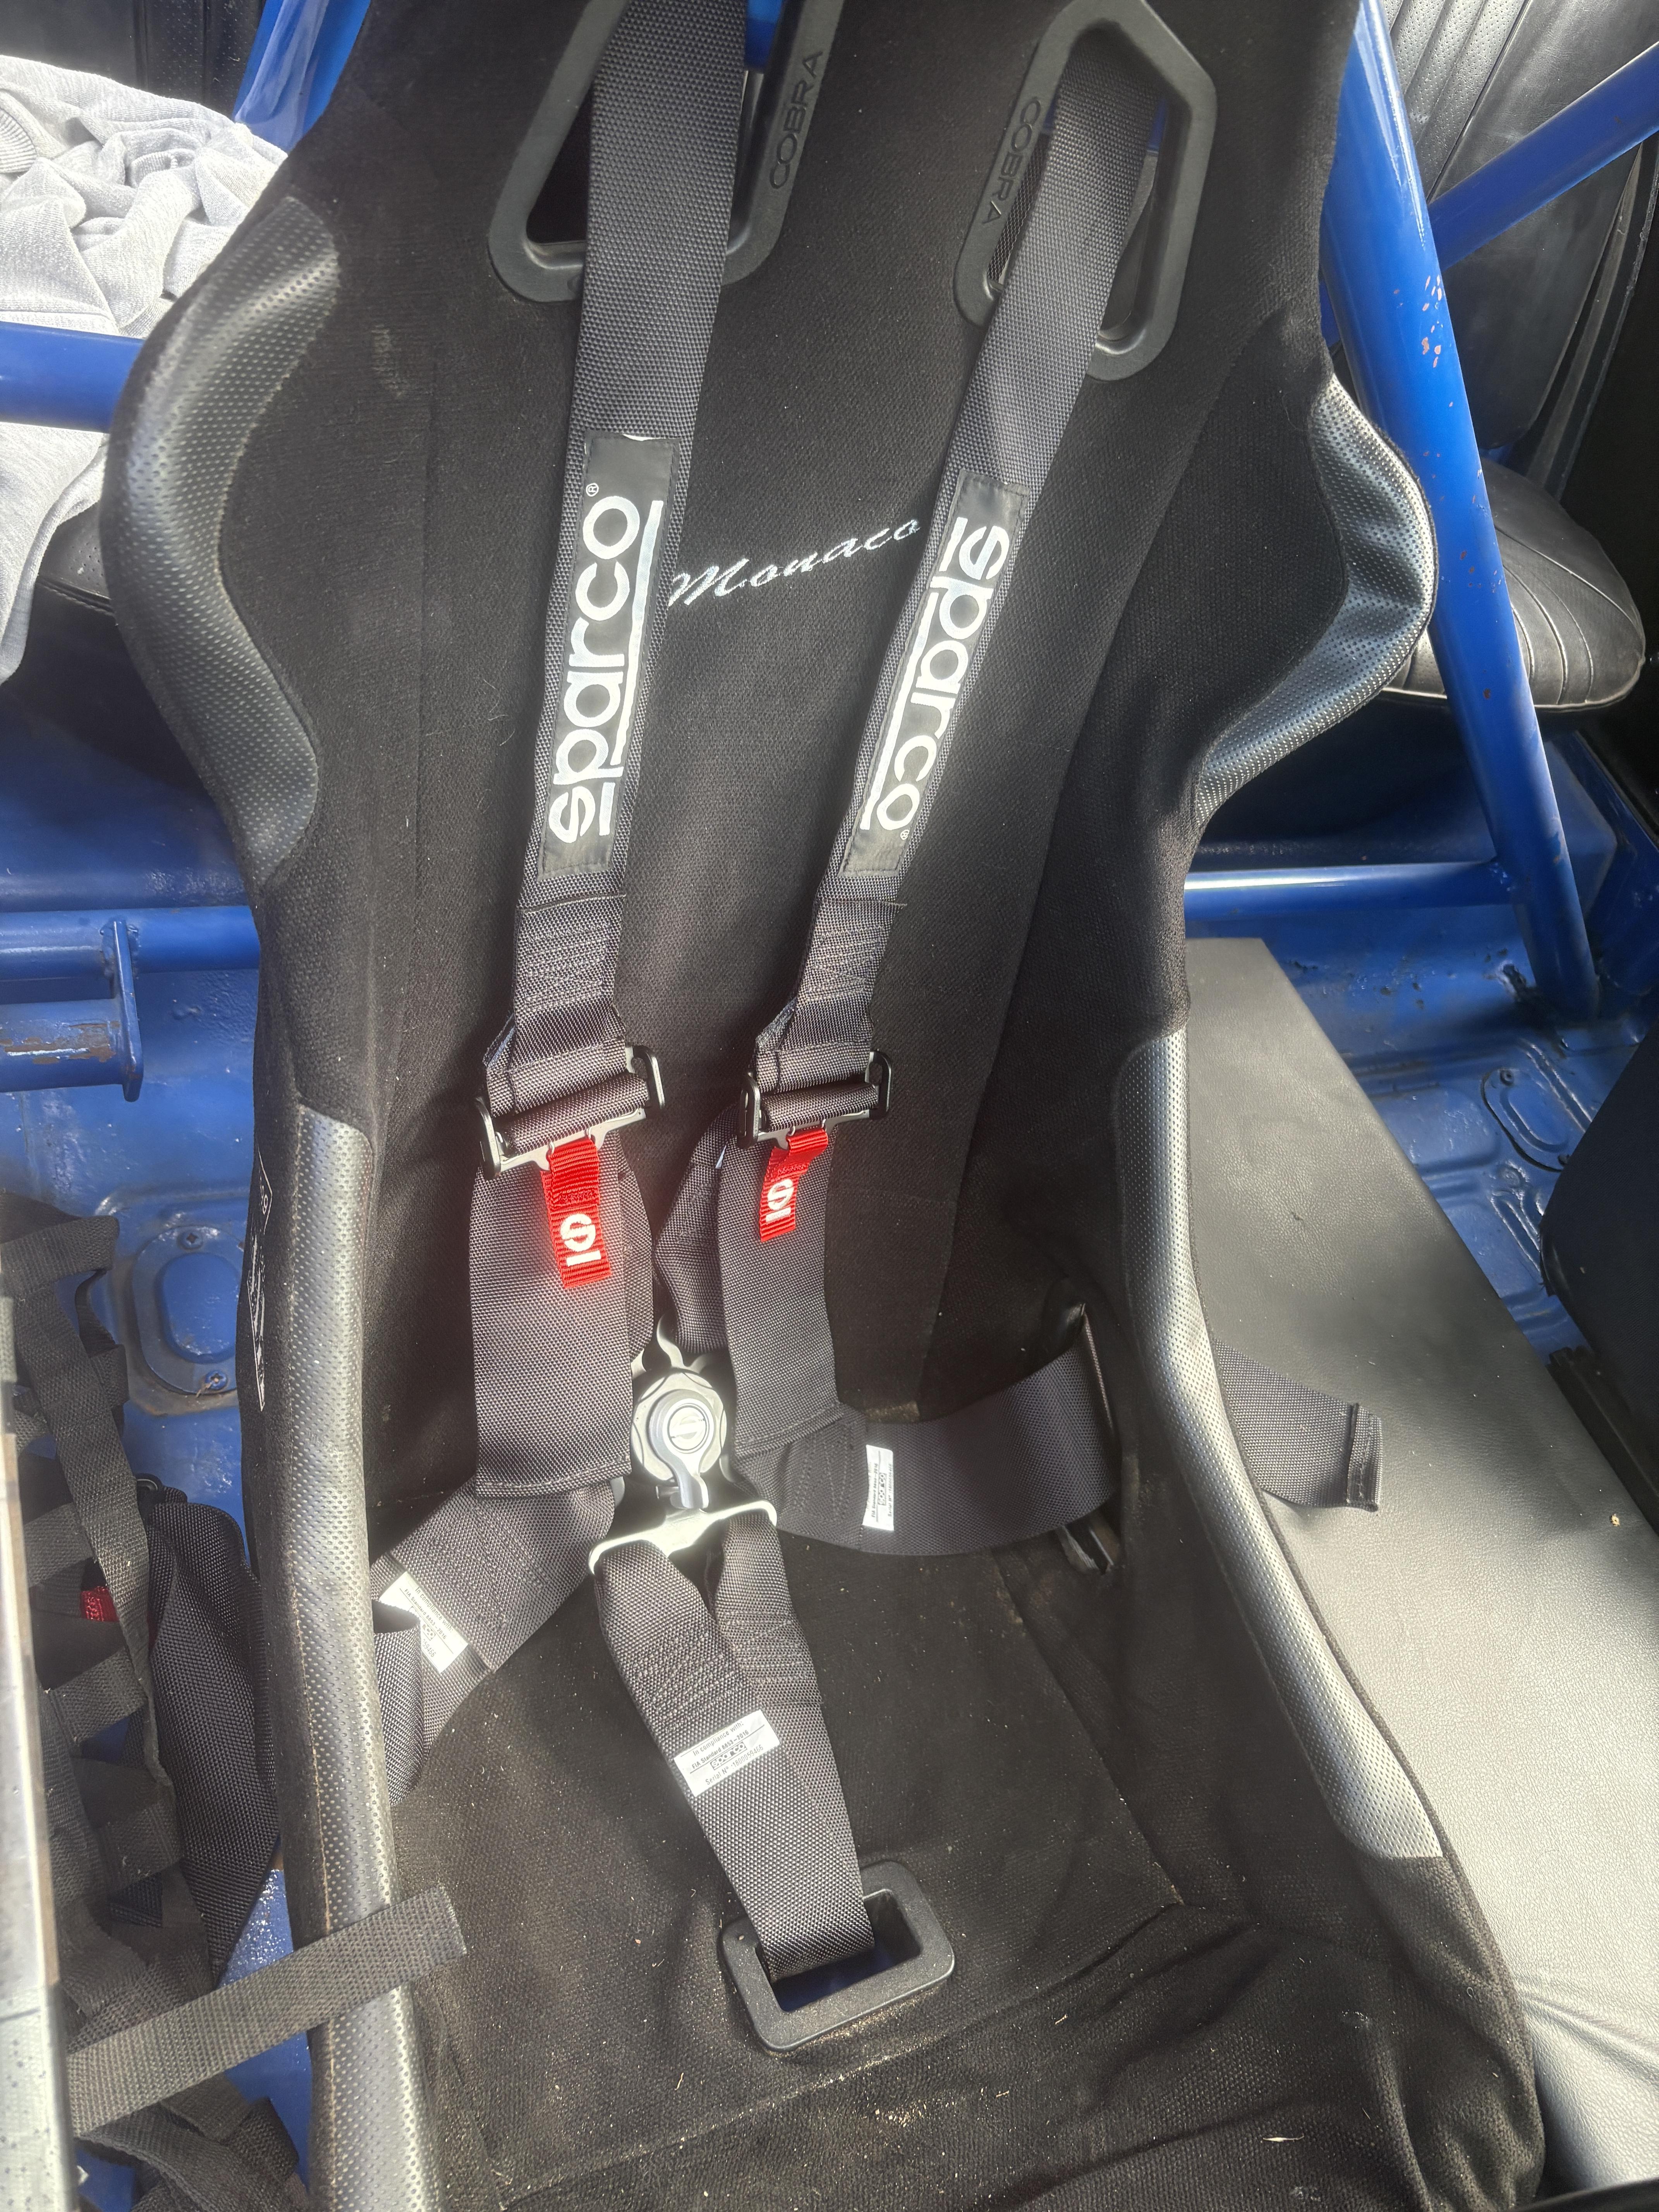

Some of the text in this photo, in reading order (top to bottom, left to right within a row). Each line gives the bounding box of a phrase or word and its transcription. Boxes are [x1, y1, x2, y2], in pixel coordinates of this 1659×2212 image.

[769, 51, 823, 189] COBRA
[982, 96, 1041, 224] COBRA
[668, 520, 919, 606] Monaco
[411, 1597, 426, 1615] Standard
[419, 1594, 444, 1620] compliance
[700, 1732, 729, 1752] compliance
[730, 1721, 744, 1732] with:
[701, 1747, 721, 1762] Standard
[705, 1772, 721, 1784] Serial
